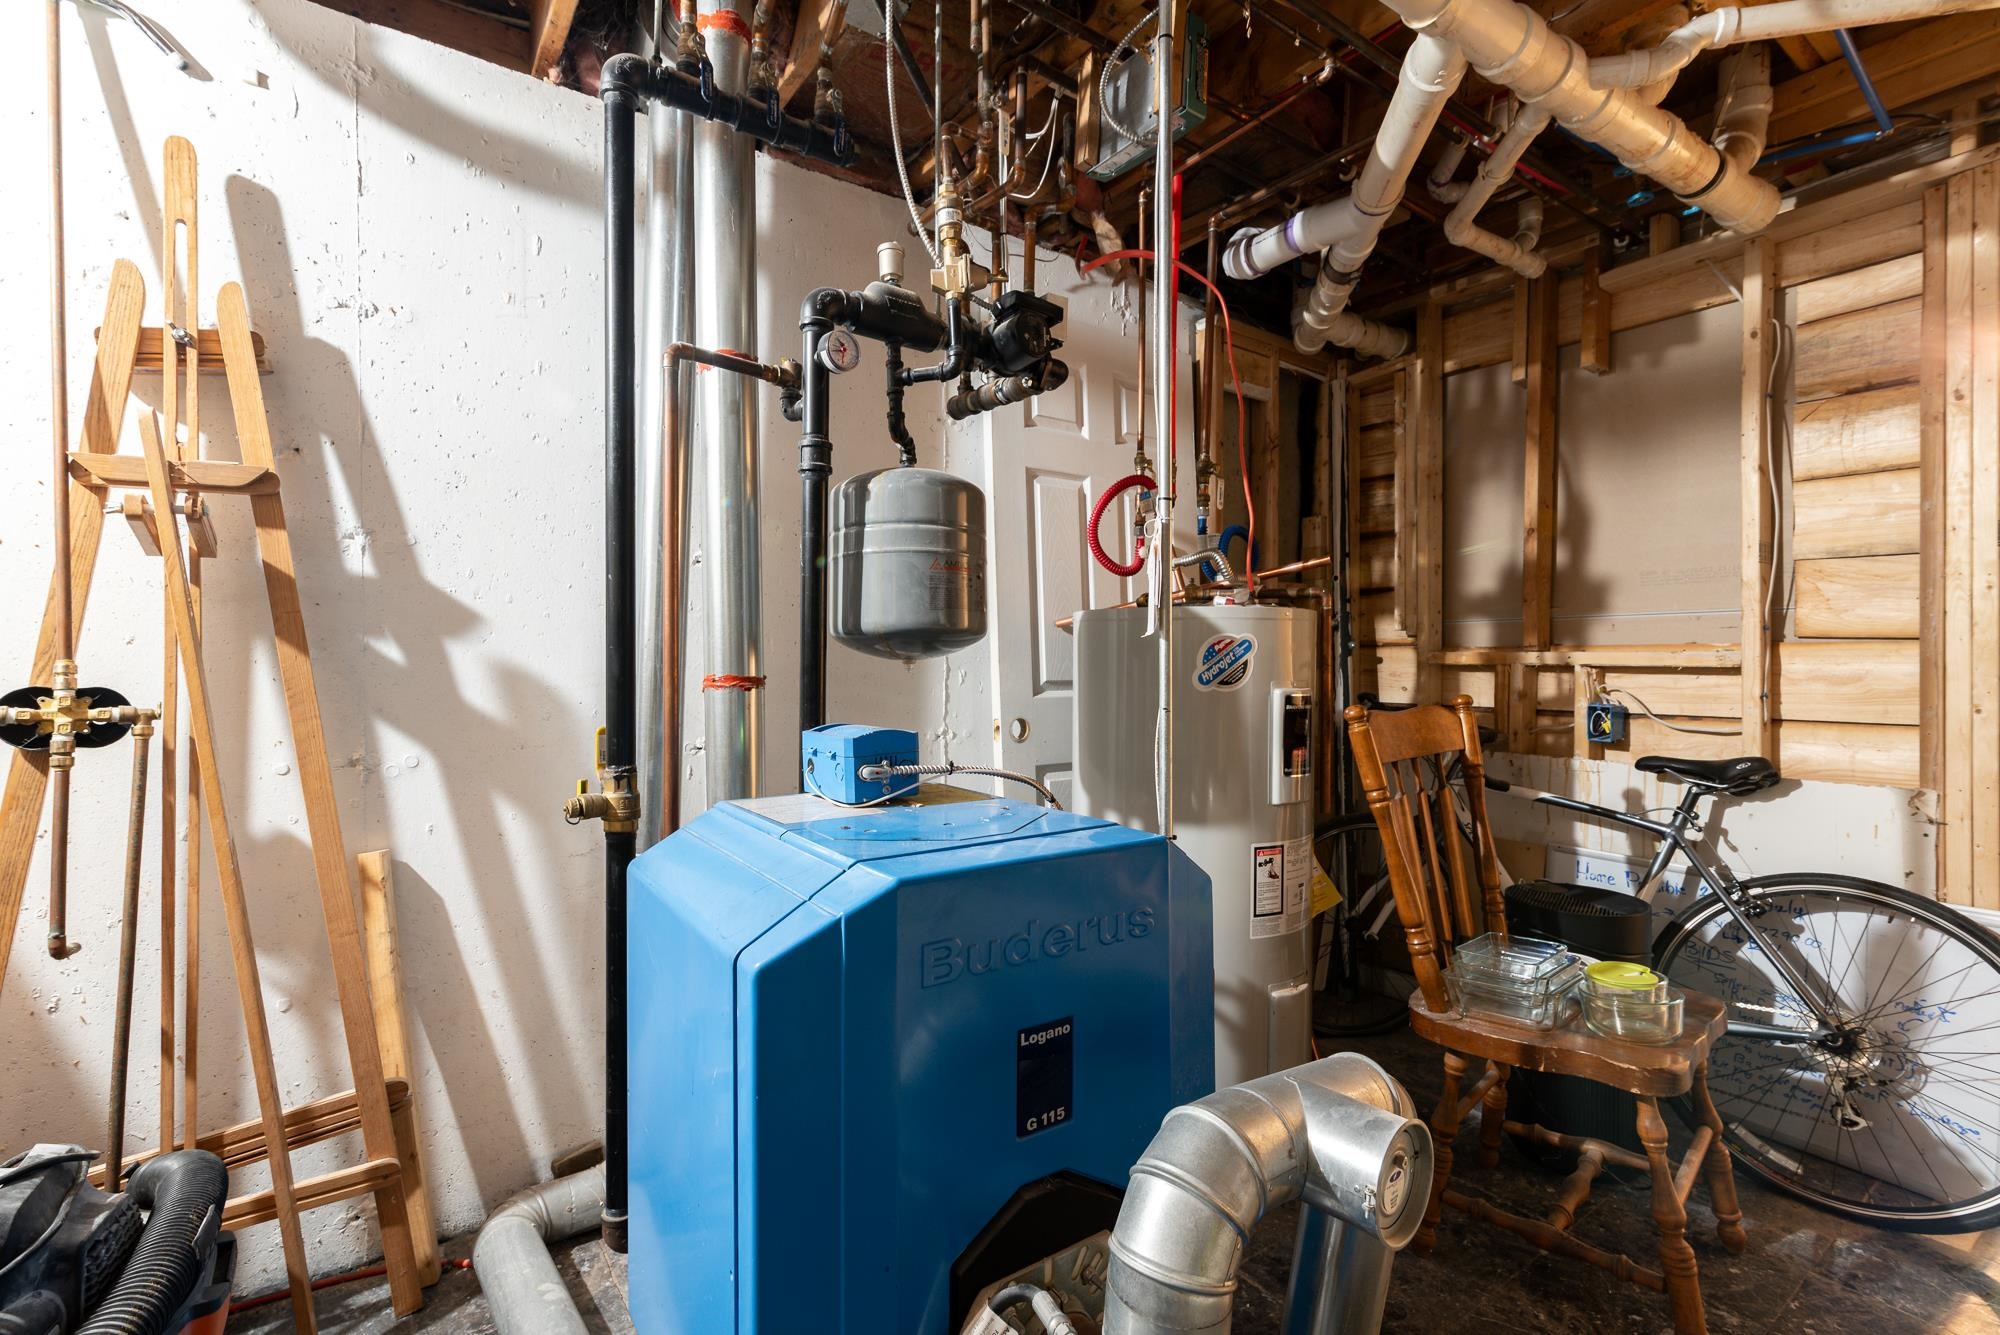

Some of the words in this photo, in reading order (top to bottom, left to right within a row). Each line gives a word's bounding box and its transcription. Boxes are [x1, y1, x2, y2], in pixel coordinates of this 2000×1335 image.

[1201, 652, 1235, 682] Hydrojet
[1576, 859, 1616, 886] Home
[921, 905, 1156, 989] Buderus
[1020, 1024, 1070, 1046] Logano
[1026, 1117, 1038, 1131] G
[1041, 1106, 1066, 1126] 115
